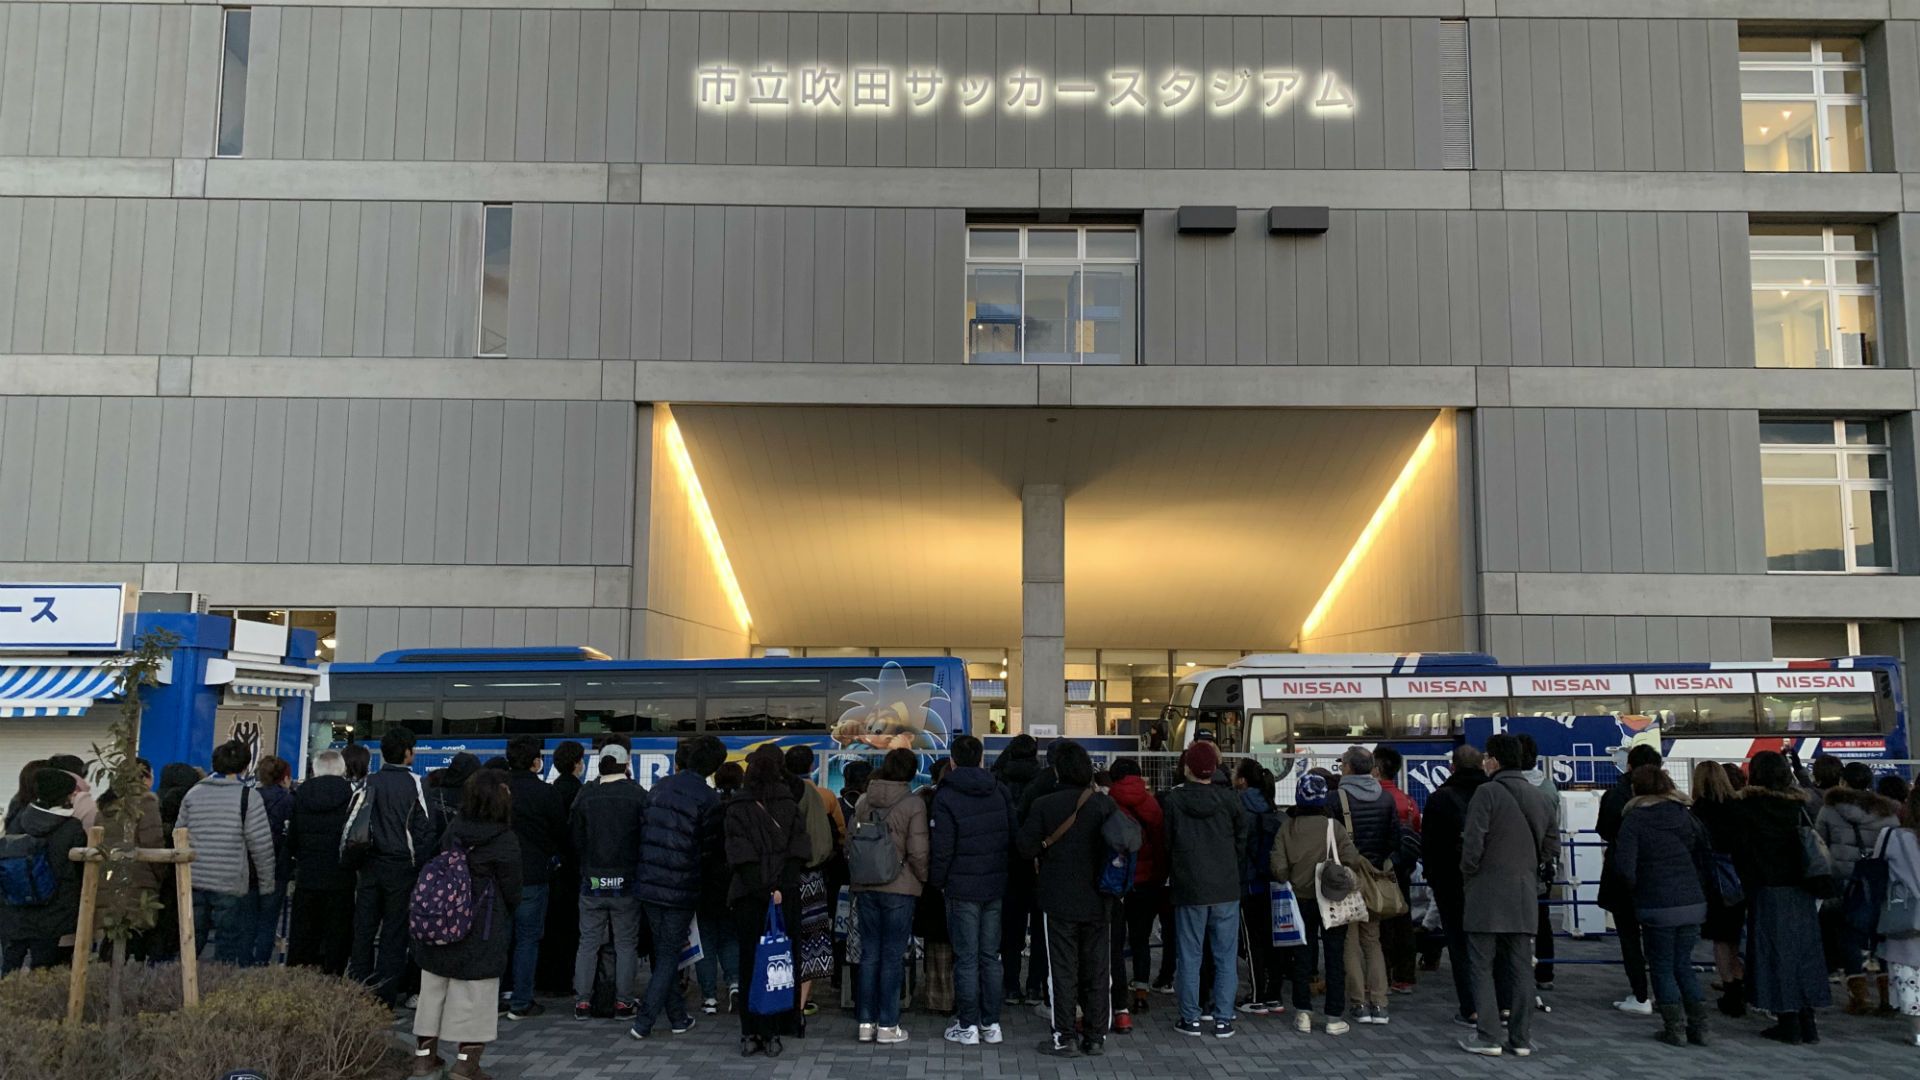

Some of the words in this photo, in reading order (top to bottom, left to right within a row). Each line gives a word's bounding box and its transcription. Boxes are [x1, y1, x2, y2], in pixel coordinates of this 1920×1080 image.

[699, 64, 1356, 110] 市立吹田サッカースタジアム
[1282, 681, 1362, 695] NISSAN
[1407, 680, 1487, 693] NISSAN
[1531, 678, 1611, 692] NISSAN
[1655, 676, 1734, 690] NISSAN
[1776, 675, 1856, 688] NISSAN
[600, 877, 624, 887] SHIP
